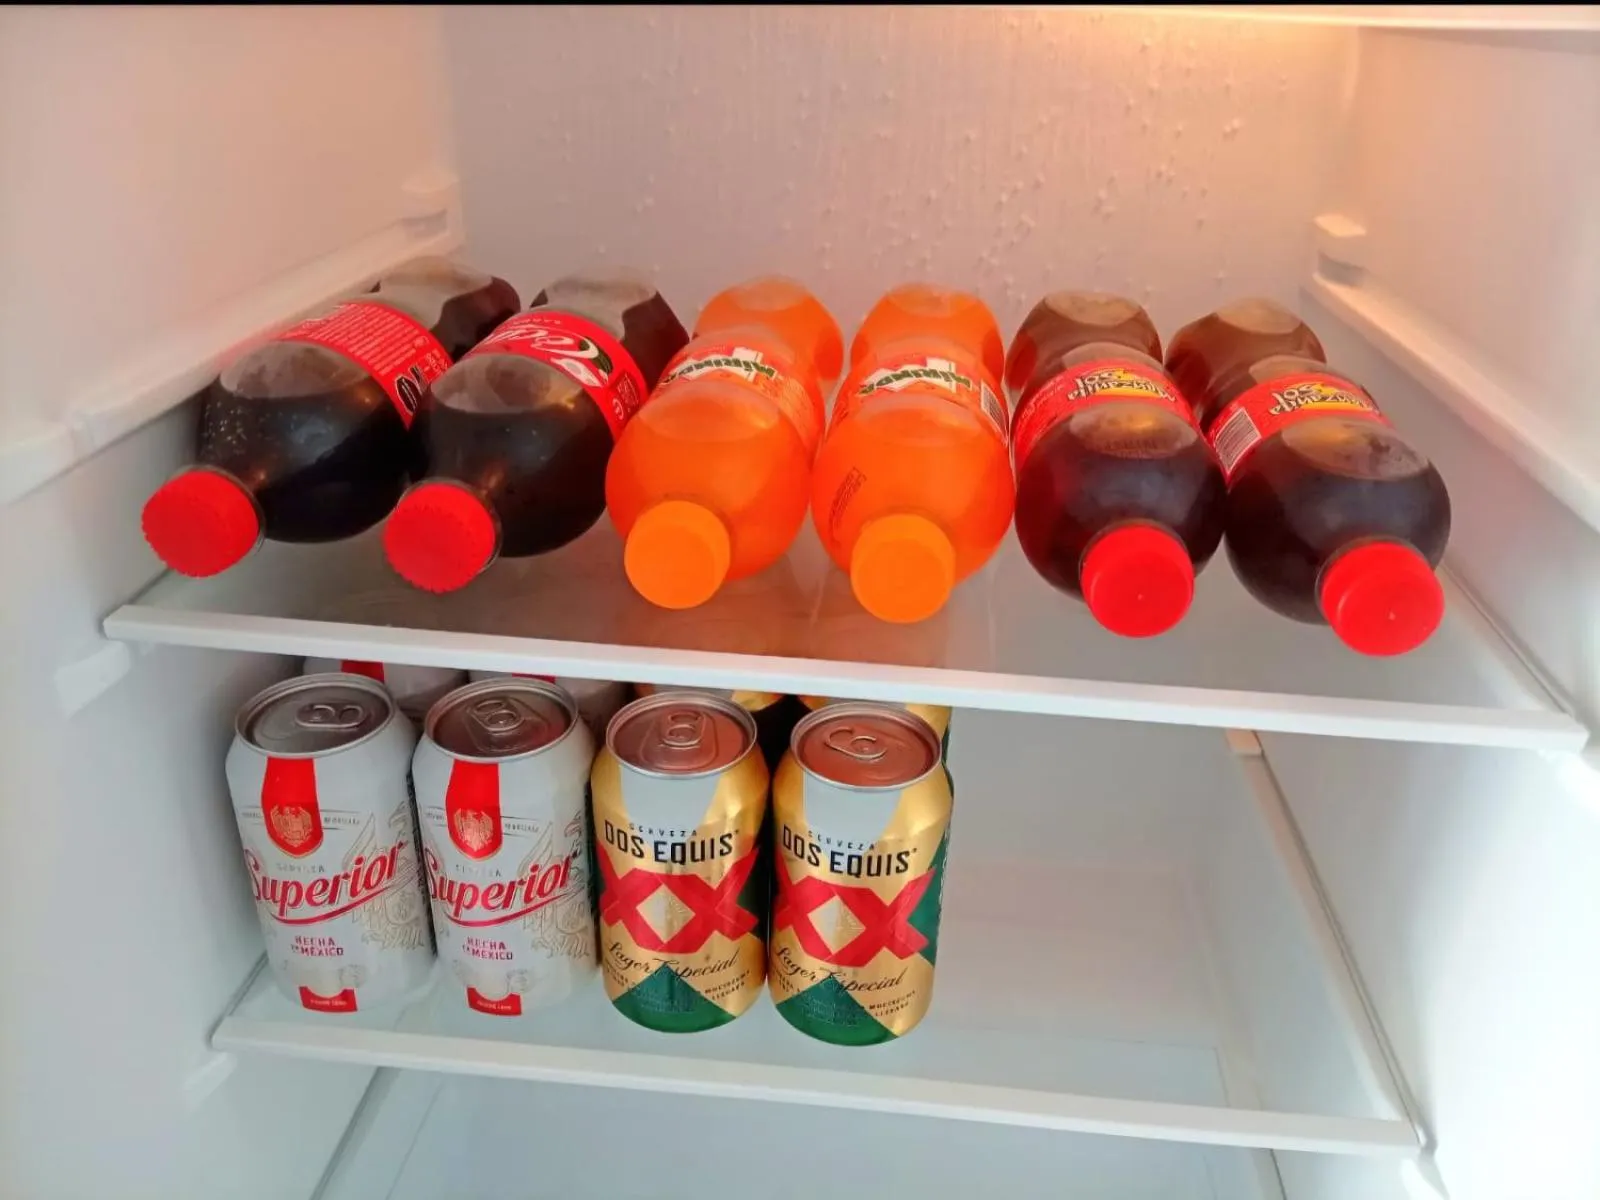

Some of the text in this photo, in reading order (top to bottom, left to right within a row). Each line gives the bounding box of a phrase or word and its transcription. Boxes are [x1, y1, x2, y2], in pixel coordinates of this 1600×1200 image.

[605, 819, 734, 866] DOS EQUIS
[629, 822, 698, 837] CERVEZA
[808, 830, 875, 851] CERVEZA
[783, 823, 910, 879] DOS EQUIS
[243, 840, 406, 917] Superior
[424, 848, 578, 918] Superior
[610, 941, 652, 975] Lager
[777, 946, 818, 981] Lager
